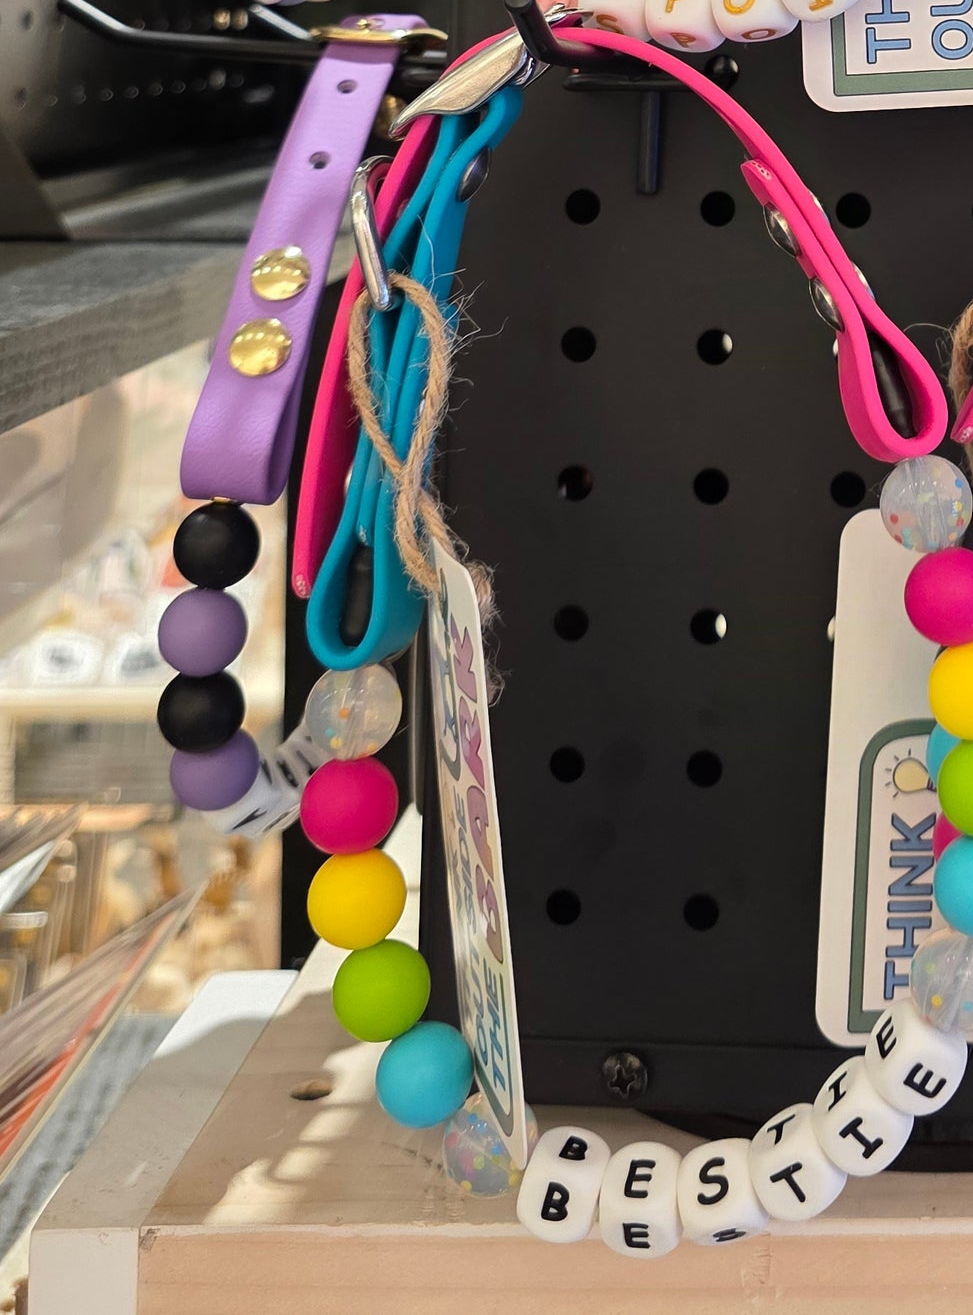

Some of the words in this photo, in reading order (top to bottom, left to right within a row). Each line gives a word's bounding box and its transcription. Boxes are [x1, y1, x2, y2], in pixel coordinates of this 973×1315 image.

[450, 612, 504, 965] BARK
[453, 784, 488, 1068] OUTSIDE
[883, 812, 938, 1002] THINK
[483, 957, 506, 1092] THE
[541, 1061, 948, 1223] BESTIE
